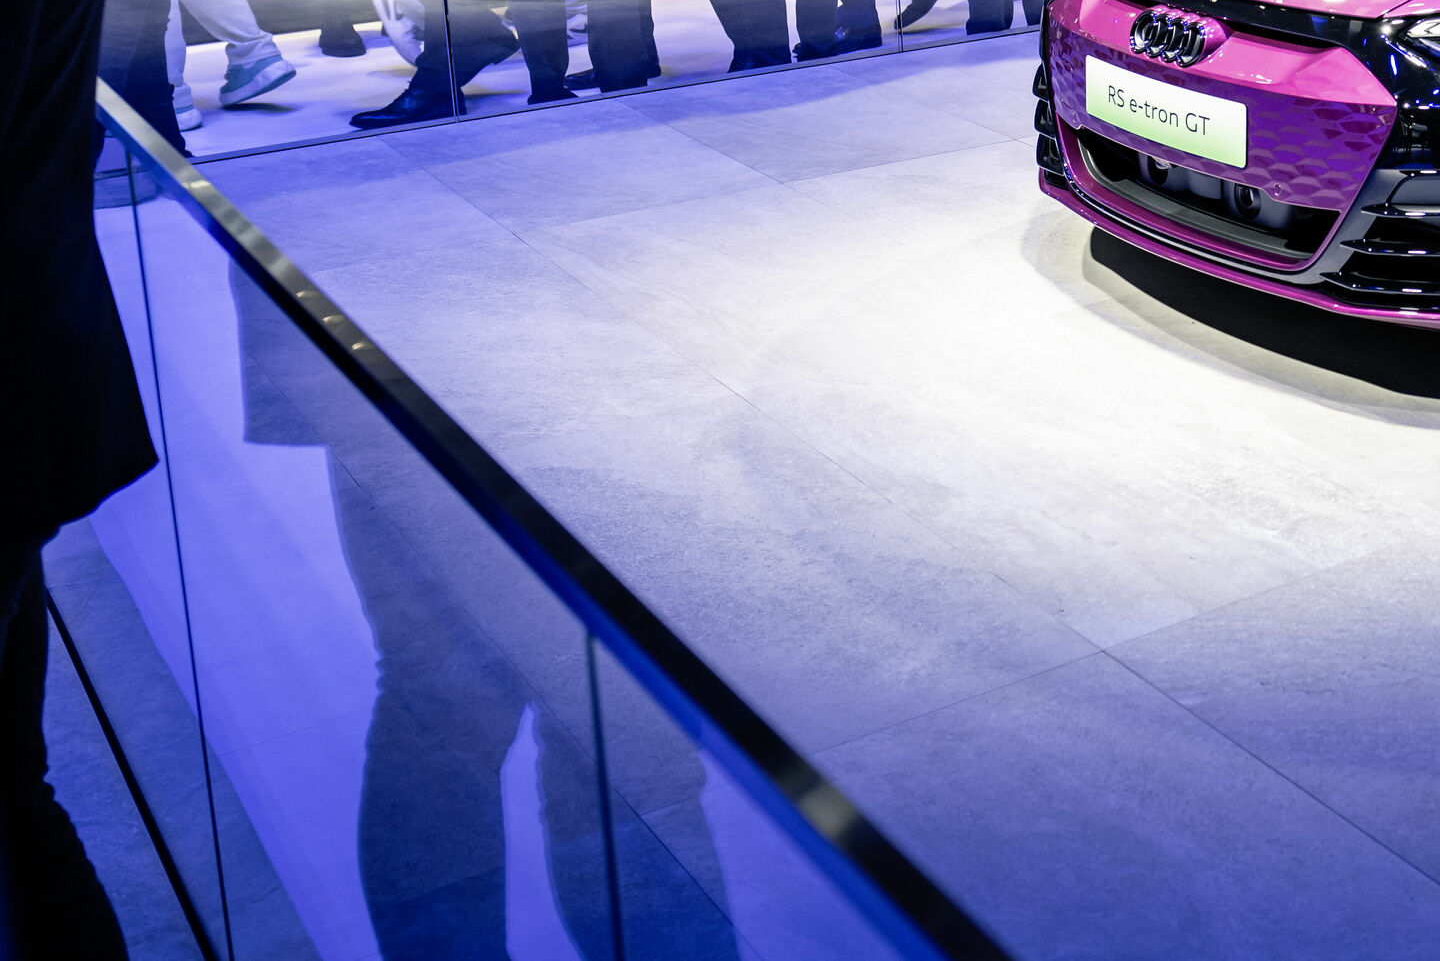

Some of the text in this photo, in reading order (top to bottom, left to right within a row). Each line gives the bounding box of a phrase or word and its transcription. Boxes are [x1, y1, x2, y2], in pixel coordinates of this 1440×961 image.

[1108, 85, 1211, 136] RS e-tron GT
